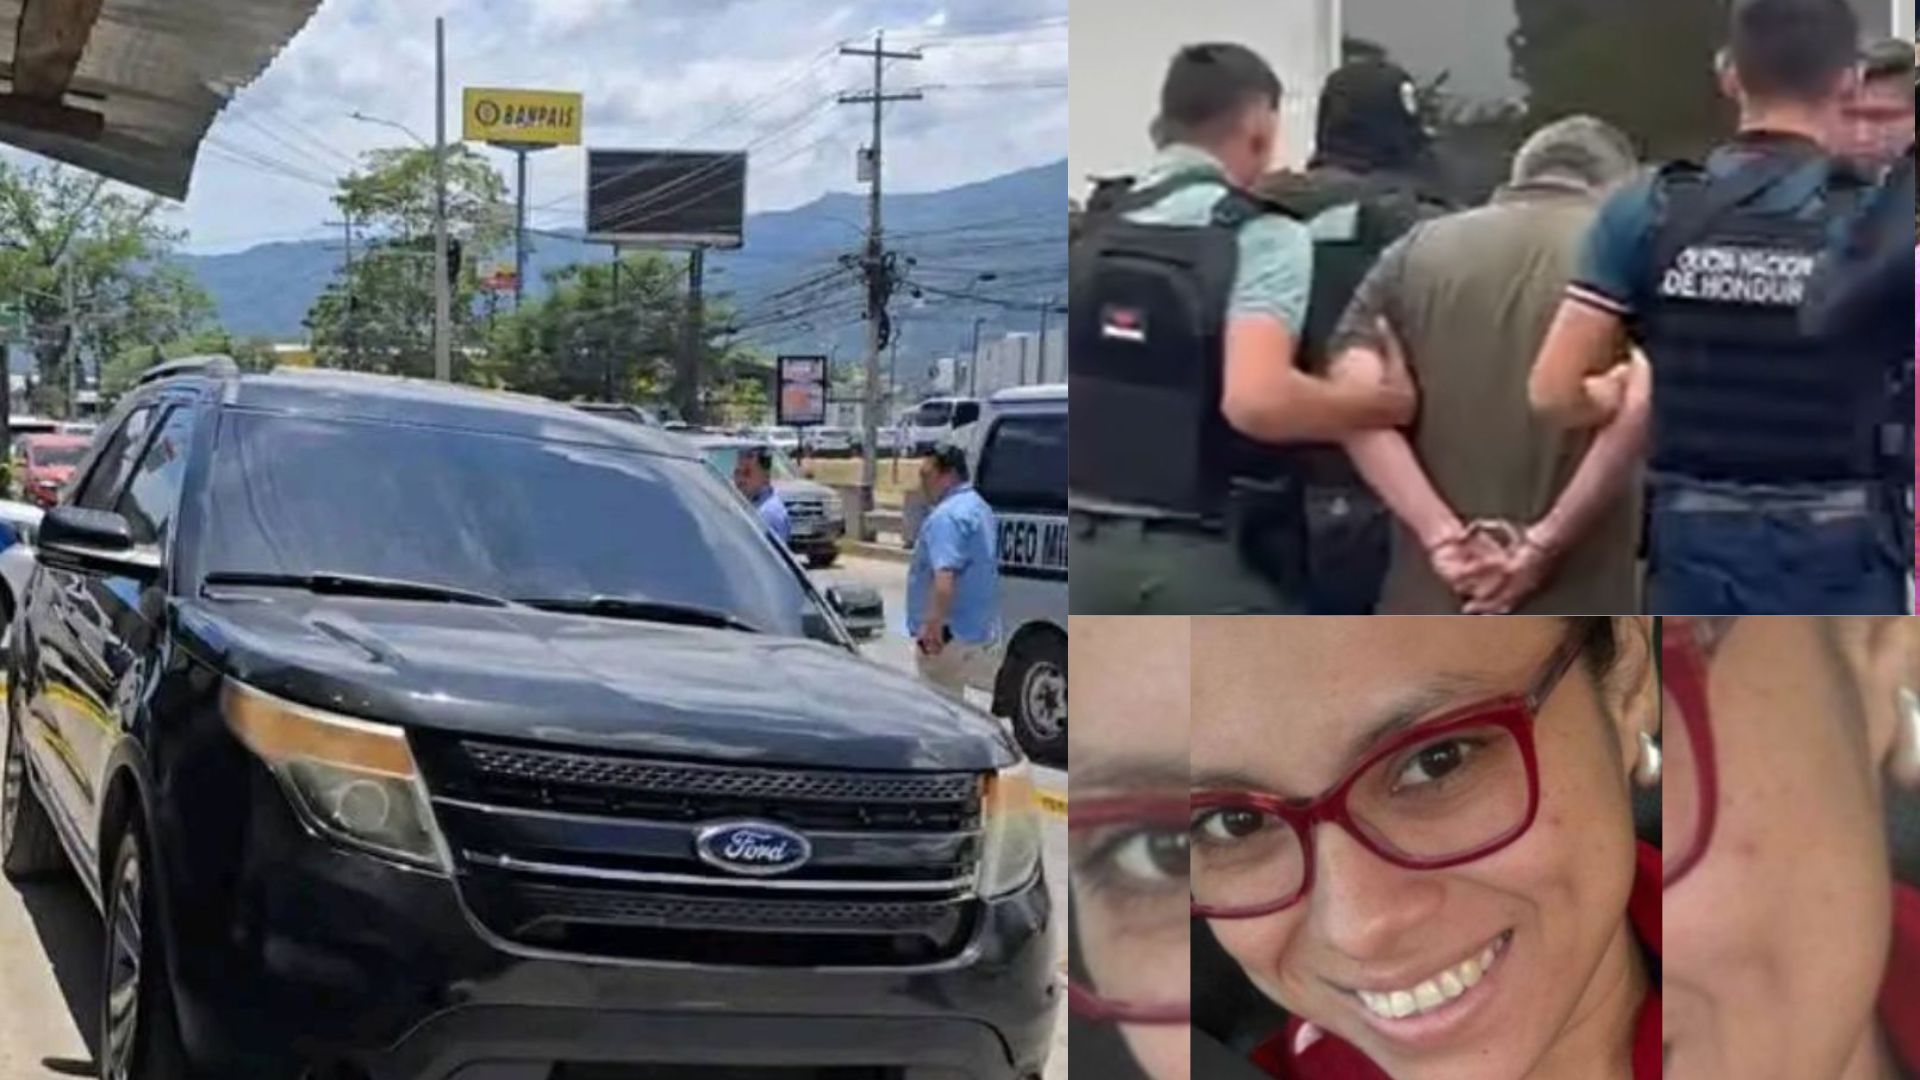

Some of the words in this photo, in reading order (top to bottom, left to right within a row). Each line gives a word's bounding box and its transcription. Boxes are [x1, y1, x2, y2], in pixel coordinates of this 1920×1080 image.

[1662, 268, 1698, 298] DE
[1701, 273, 1804, 307] HONDUR
[995, 519, 1038, 565] ICEO
[724, 829, 788, 860] Ford
